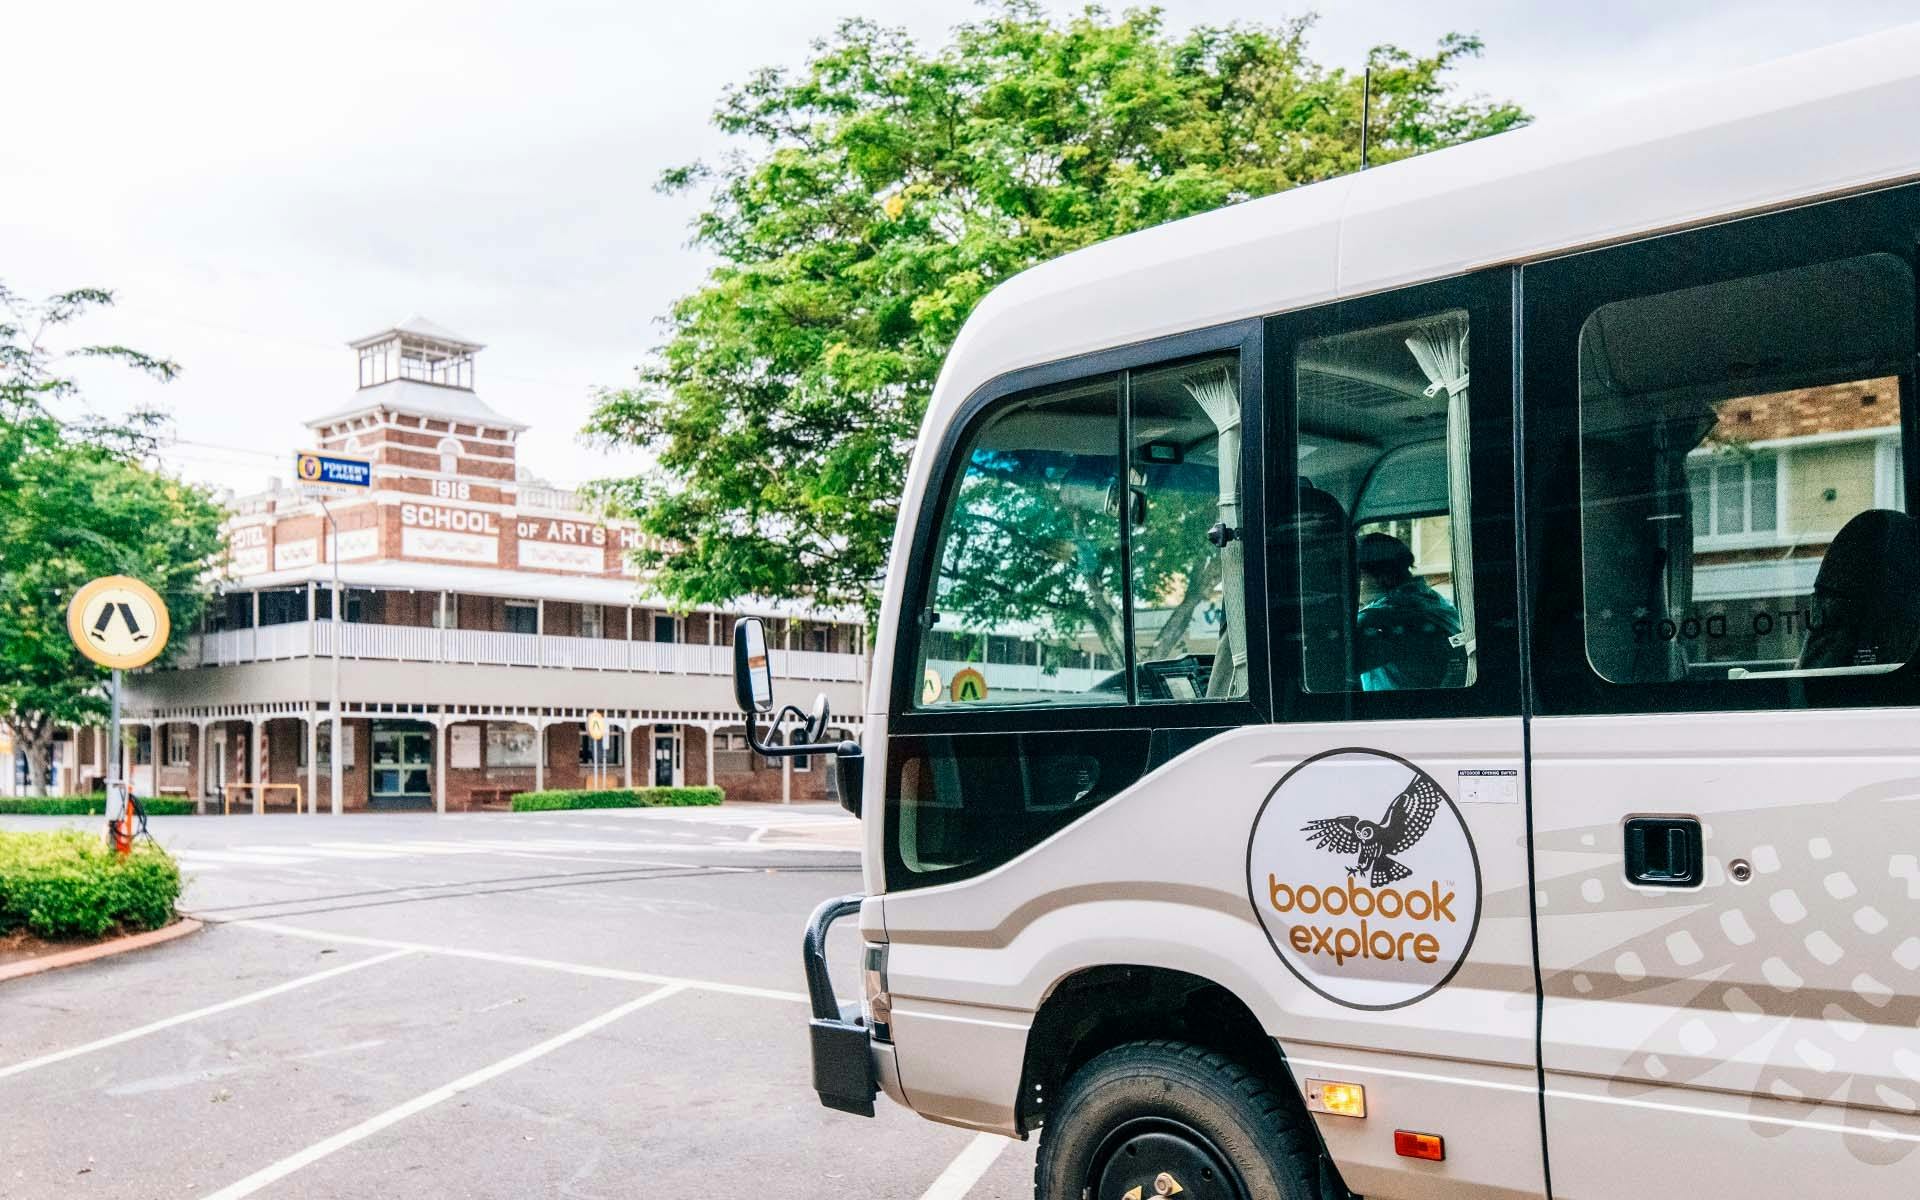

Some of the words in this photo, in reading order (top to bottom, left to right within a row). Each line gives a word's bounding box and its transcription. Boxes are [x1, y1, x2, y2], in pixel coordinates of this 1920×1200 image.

[401, 504, 500, 533] SCHOOL
[517, 522, 539, 538] OF
[547, 522, 607, 545] ARTS
[1269, 873, 1456, 923] boobook
[1289, 918, 1440, 966] explore
